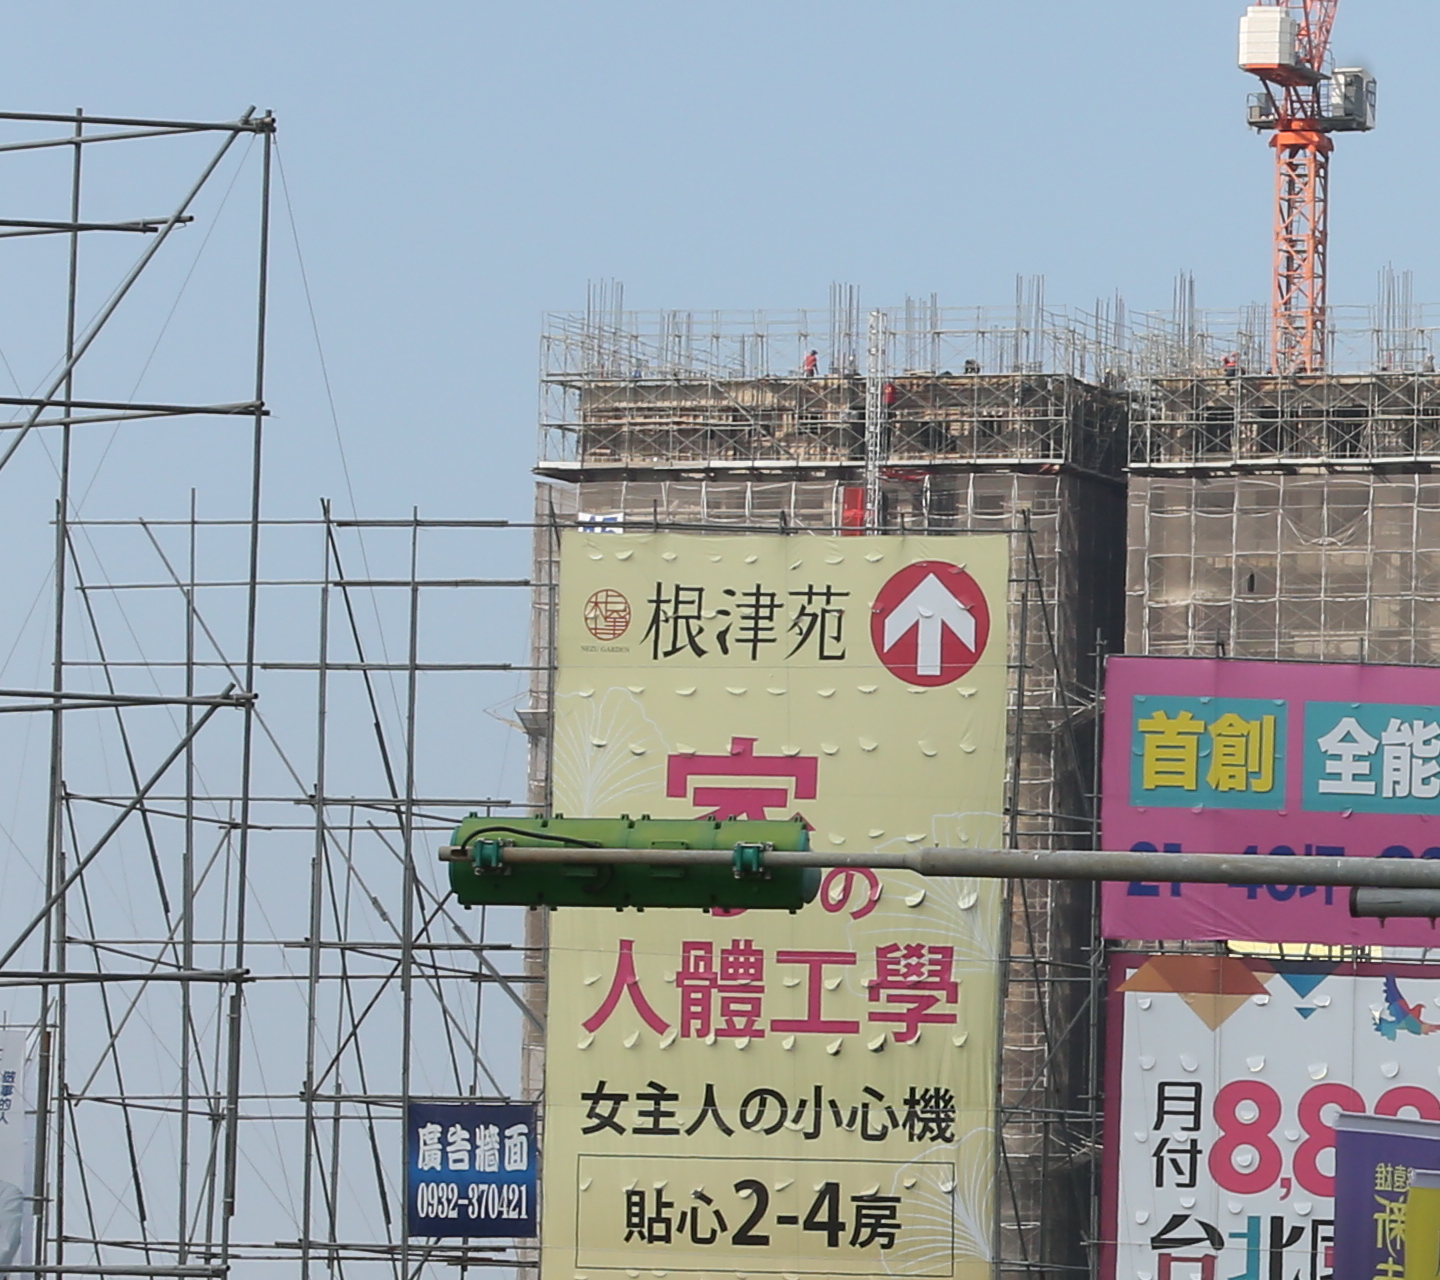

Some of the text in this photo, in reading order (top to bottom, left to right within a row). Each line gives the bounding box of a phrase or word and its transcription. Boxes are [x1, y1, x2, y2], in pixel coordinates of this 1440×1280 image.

[640, 581, 850, 662] 根津苑
[1138, 711, 1277, 793] 首創
[581, 938, 959, 1043] 人體工學
[416, 1122, 530, 1174] 廣告牆面
[580, 1080, 957, 1145] 女主人の小心機
[1152, 1079, 1203, 1189] 月付
[416, 1183, 529, 1221] 0932-370421
[623, 1177, 902, 1251] 貼心2-4房
